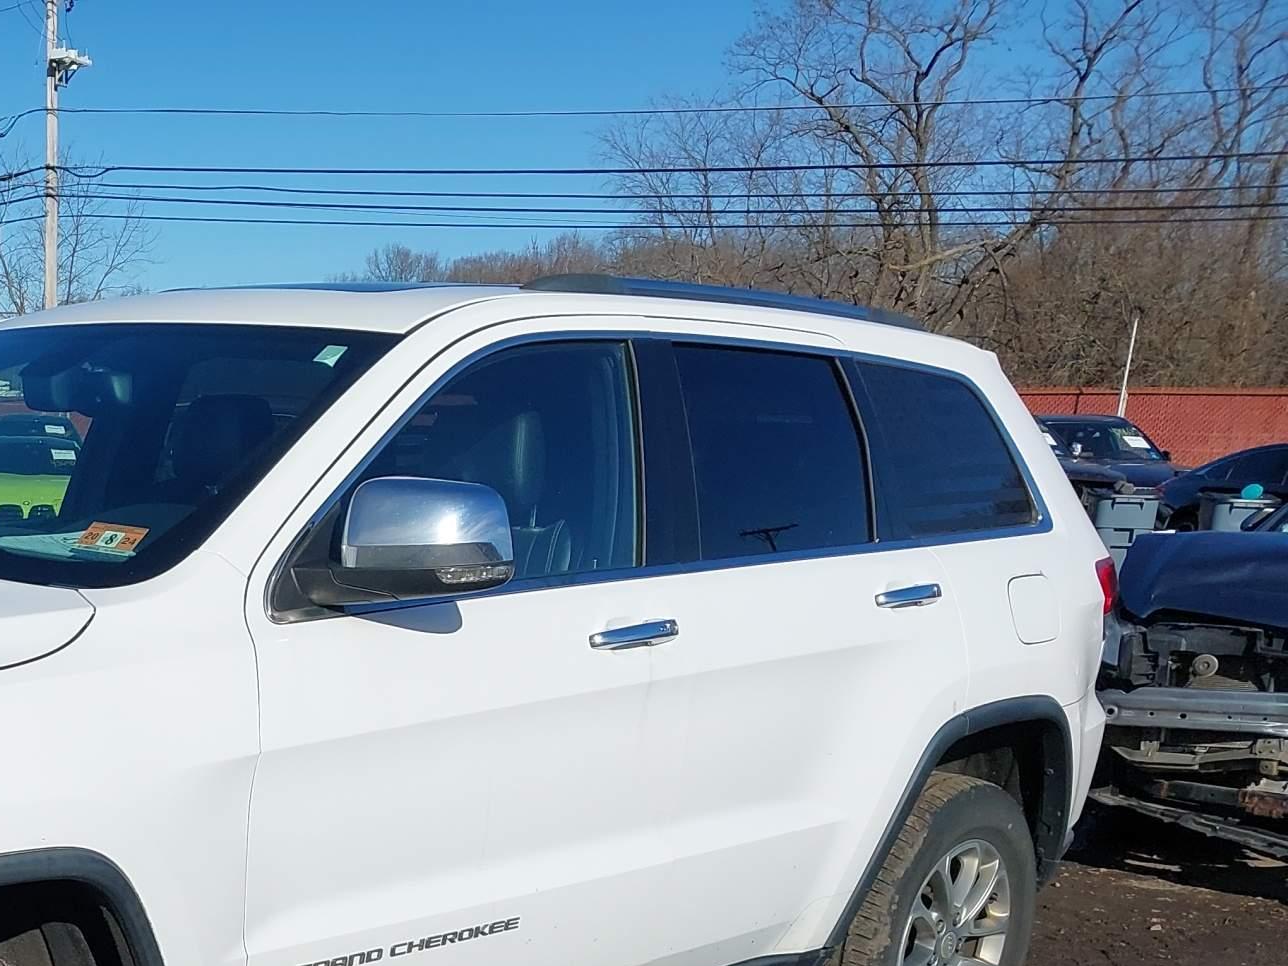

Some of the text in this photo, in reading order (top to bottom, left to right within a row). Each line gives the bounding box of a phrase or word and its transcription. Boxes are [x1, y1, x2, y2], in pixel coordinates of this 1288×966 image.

[84, 531, 100, 541] 20
[105, 533, 118, 545] 8
[389, 916, 521, 958] CHEROKEE
